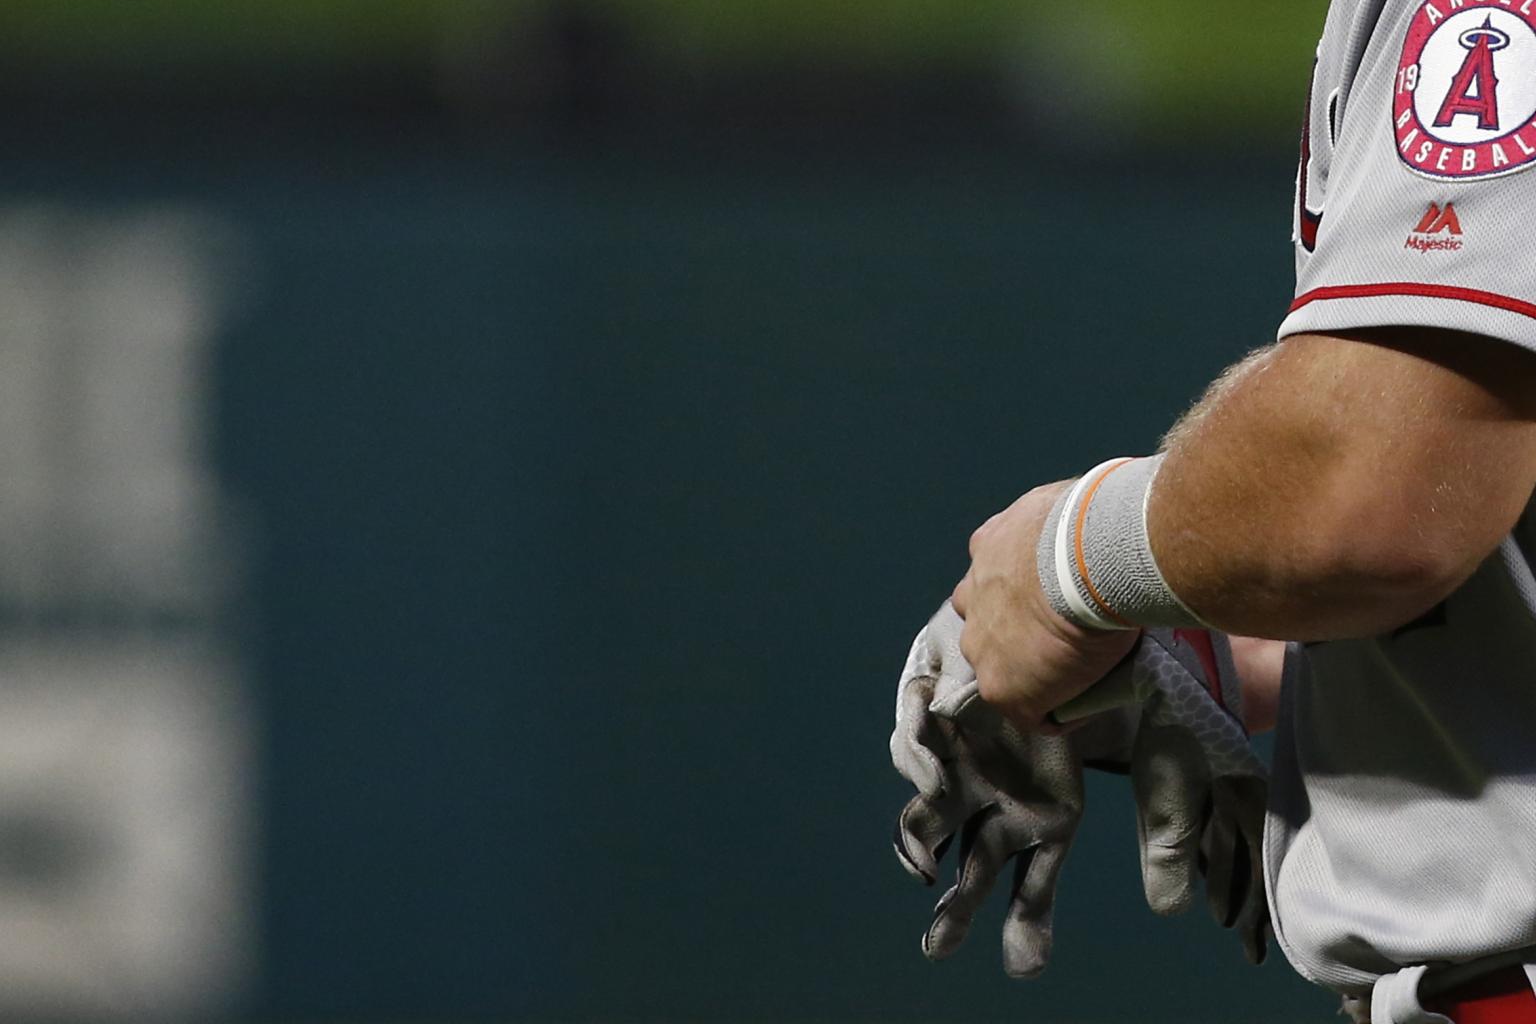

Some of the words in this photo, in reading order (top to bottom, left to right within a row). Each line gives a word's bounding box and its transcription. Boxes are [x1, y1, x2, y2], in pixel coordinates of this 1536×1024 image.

[1397, 63, 1421, 95] 19
[1432, 13, 1500, 132] A
[1403, 235, 1465, 255] Majestic
